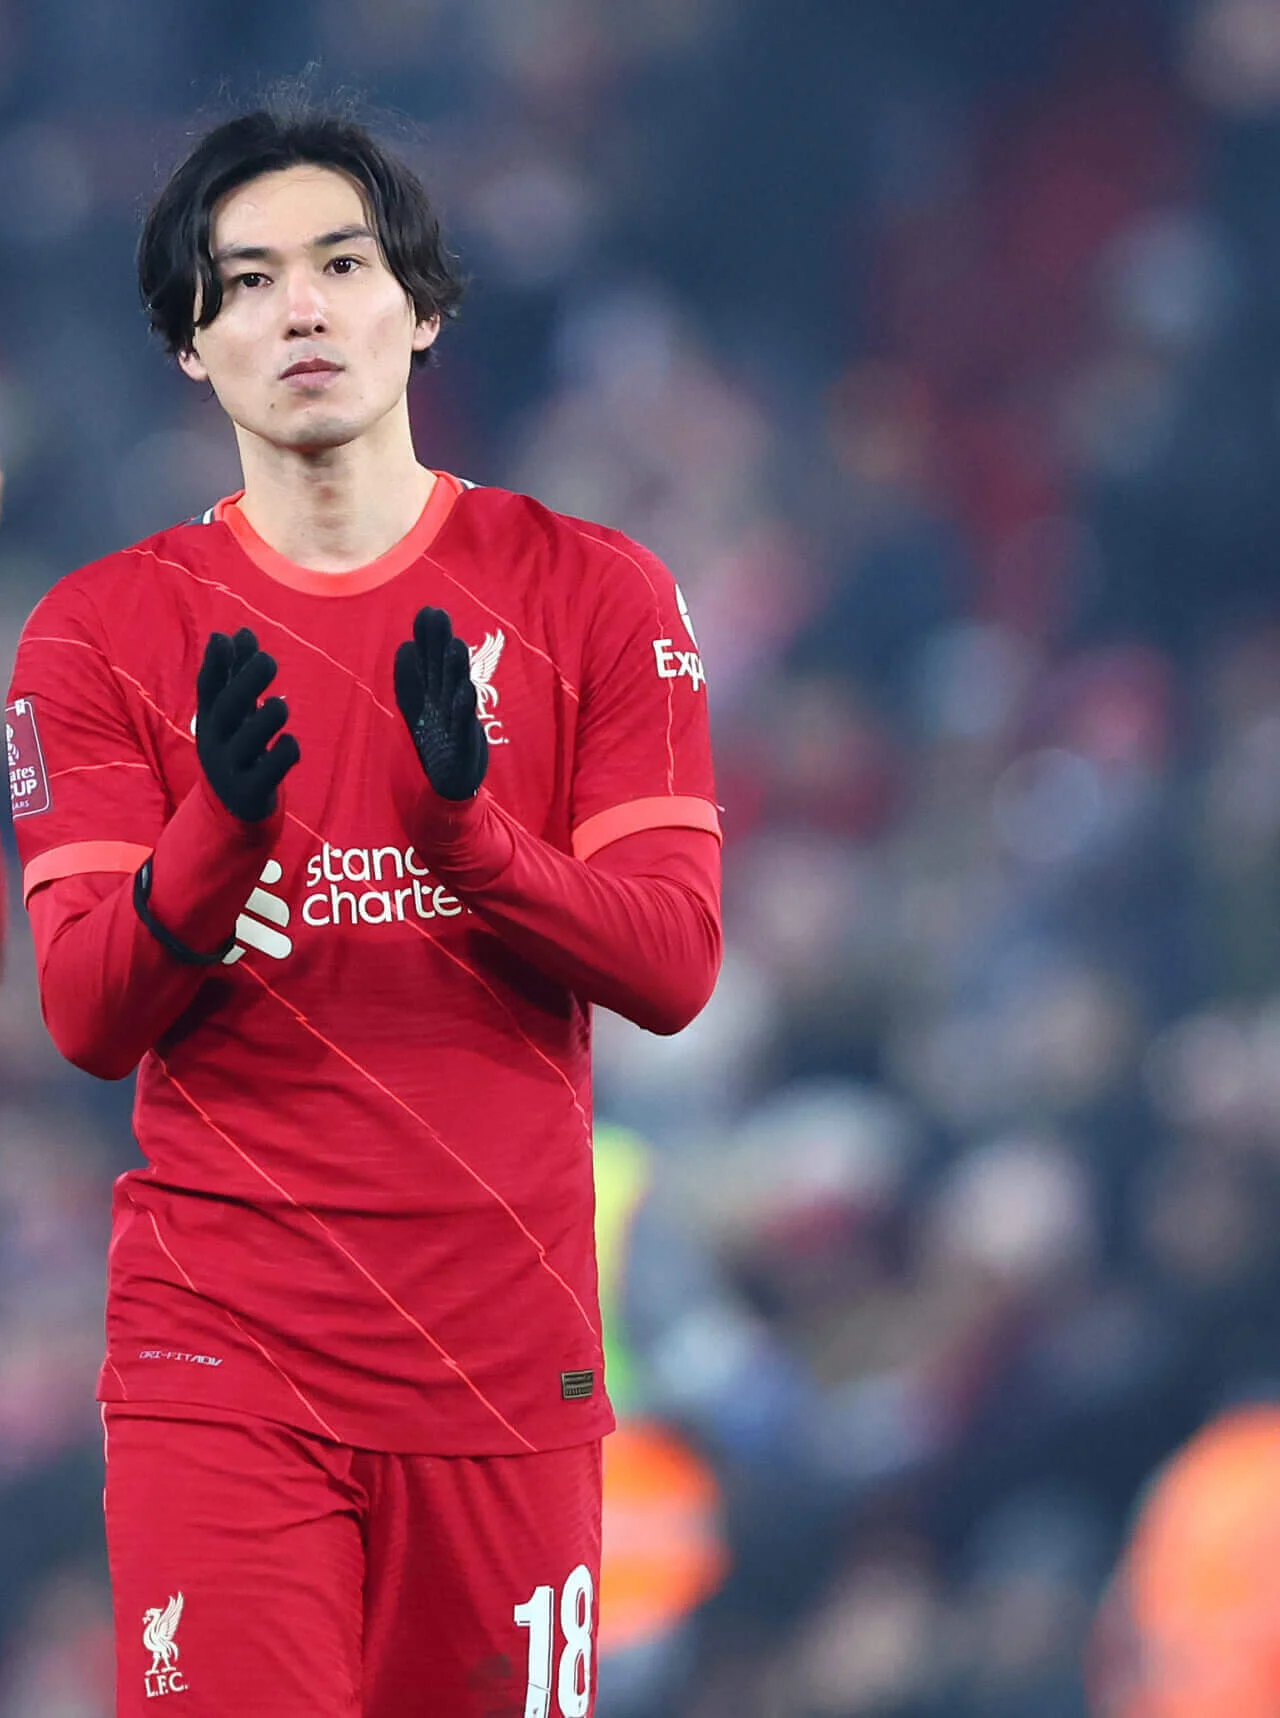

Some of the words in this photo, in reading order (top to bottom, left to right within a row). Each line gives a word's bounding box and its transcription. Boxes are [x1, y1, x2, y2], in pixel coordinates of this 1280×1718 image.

[10, 778, 38, 800] UP
[302, 879, 473, 926] charte
[514, 1564, 594, 1718] 18
